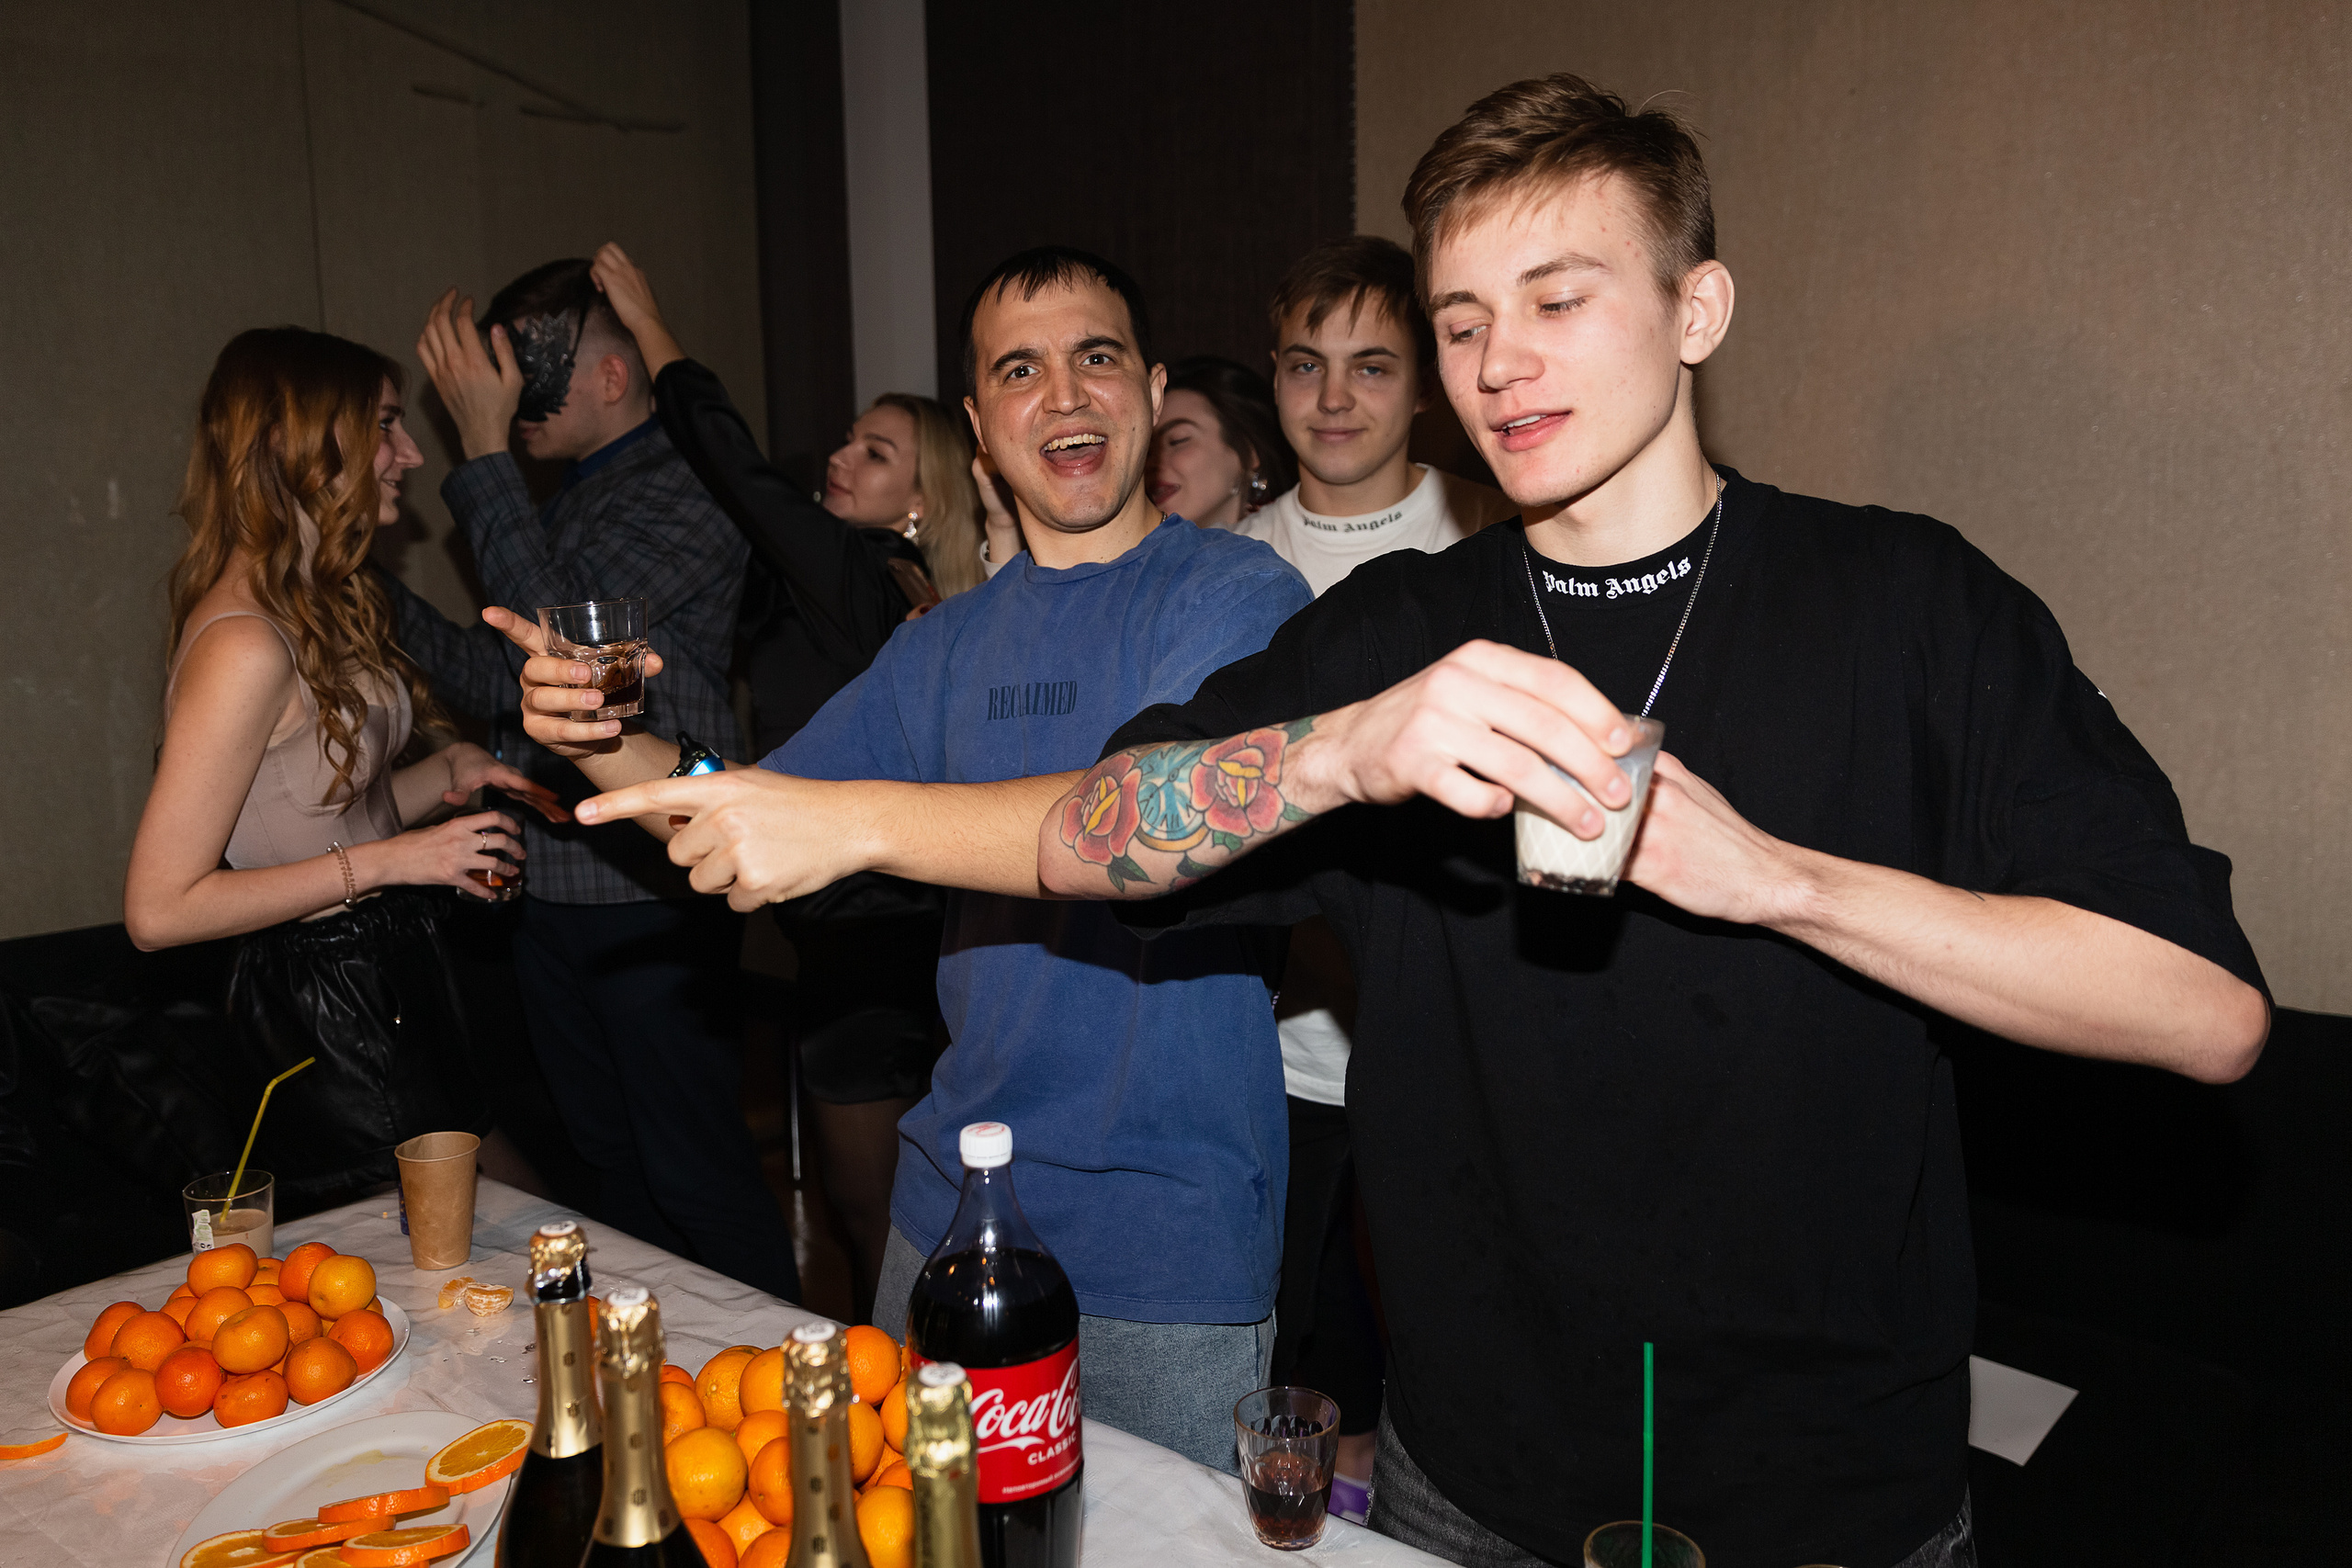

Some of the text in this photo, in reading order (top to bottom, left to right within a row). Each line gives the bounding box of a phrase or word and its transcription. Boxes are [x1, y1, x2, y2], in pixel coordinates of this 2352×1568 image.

[1302, 511, 1403, 533] Palm Angels
[1542, 557, 1691, 599] Palm Angels
[968, 1358, 1080, 1439] Coca-Co
[1027, 1431, 1076, 1465] CLASSIC
